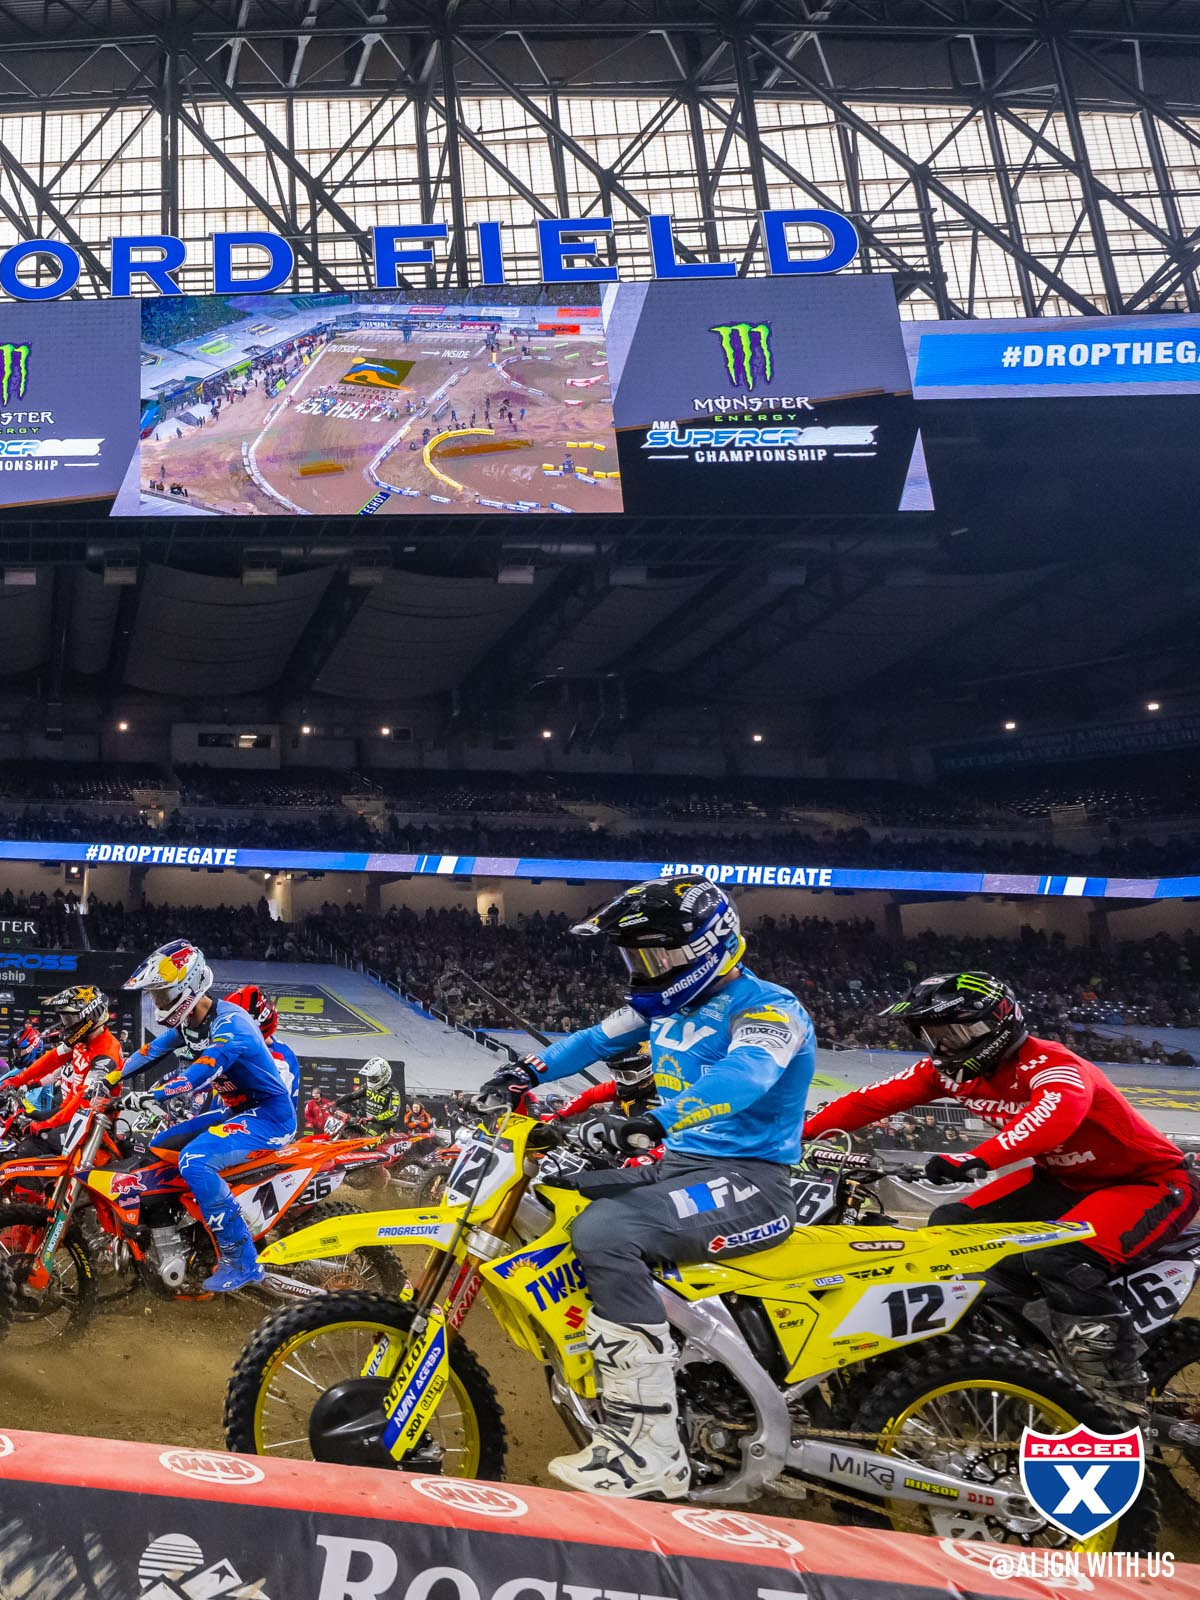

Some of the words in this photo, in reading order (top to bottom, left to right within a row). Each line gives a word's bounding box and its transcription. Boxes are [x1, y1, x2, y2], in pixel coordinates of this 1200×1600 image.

[369, 207, 860, 289] FIELD
[441, 349, 471, 359] INSIDE
[693, 396, 815, 413] MONSTER
[652, 420, 678, 431] AMA
[714, 414, 798, 422] ENERGY
[694, 448, 828, 463] CHAMPIONSHIP
[85, 844, 237, 865] #DROPTHEGATE
[178, 963, 201, 991] OAKLEY
[661, 952, 720, 1001] PROGRESSIVE
[996, 1089, 1062, 1151] FASTHOUSE
[814, 1150, 868, 1165] RENTHAL
[1047, 1151, 1096, 1167] KTM
[253, 1181, 281, 1221] 1
[47, 1218, 65, 1253] MOTOREX
[377, 1225, 440, 1237] PROGRESSIVE
[726, 1216, 790, 1248] SUZUKI
[853, 1241, 904, 1250] GUTS
[950, 1241, 1007, 1257] DUNLOP
[847, 1266, 895, 1280] FLY
[525, 1258, 590, 1313] TWIS
[882, 1284, 947, 1338] 12
[564, 1330, 586, 1341] SUZU
[383, 1333, 428, 1412] DUNLOP
[415, 1346, 442, 1390] ACERBIS
[828, 1452, 895, 1486] Mika
[904, 1477, 960, 1499] HINSON
[967, 1492, 996, 1507] DID
